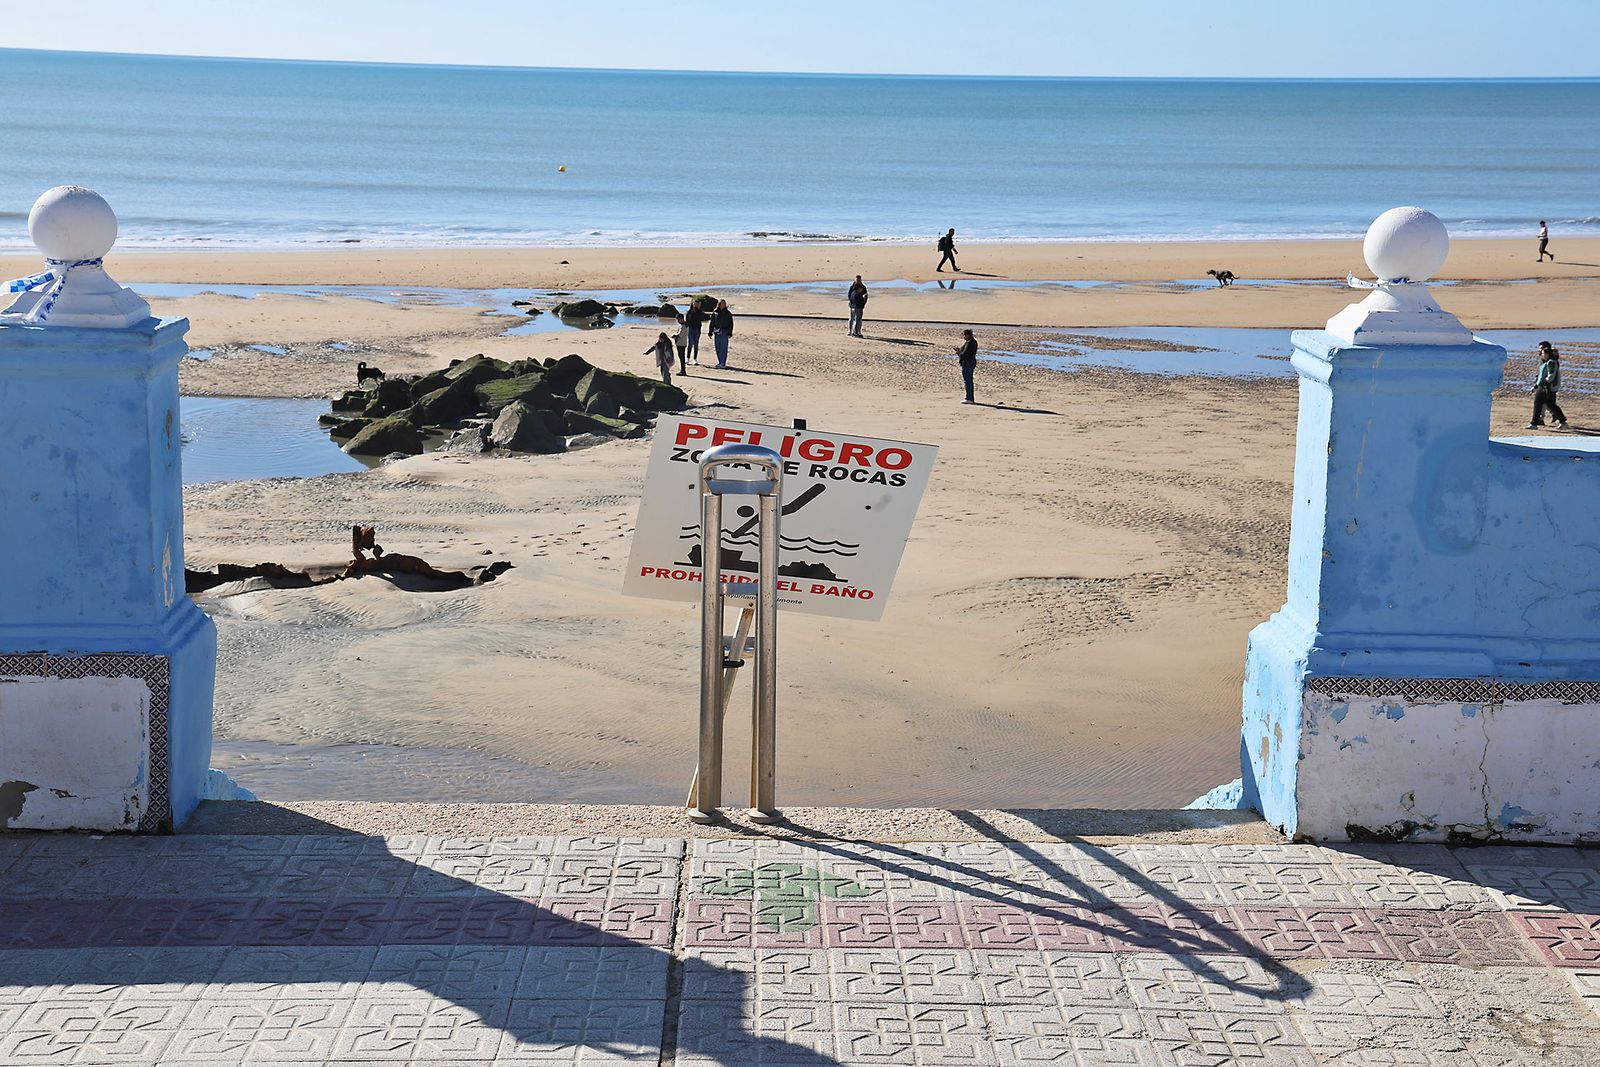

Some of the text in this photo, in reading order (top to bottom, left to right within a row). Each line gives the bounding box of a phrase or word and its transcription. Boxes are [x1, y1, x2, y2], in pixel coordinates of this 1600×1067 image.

[808, 463, 907, 487] ROCAS
[640, 566, 874, 600] PROHBID EL BAÑO
